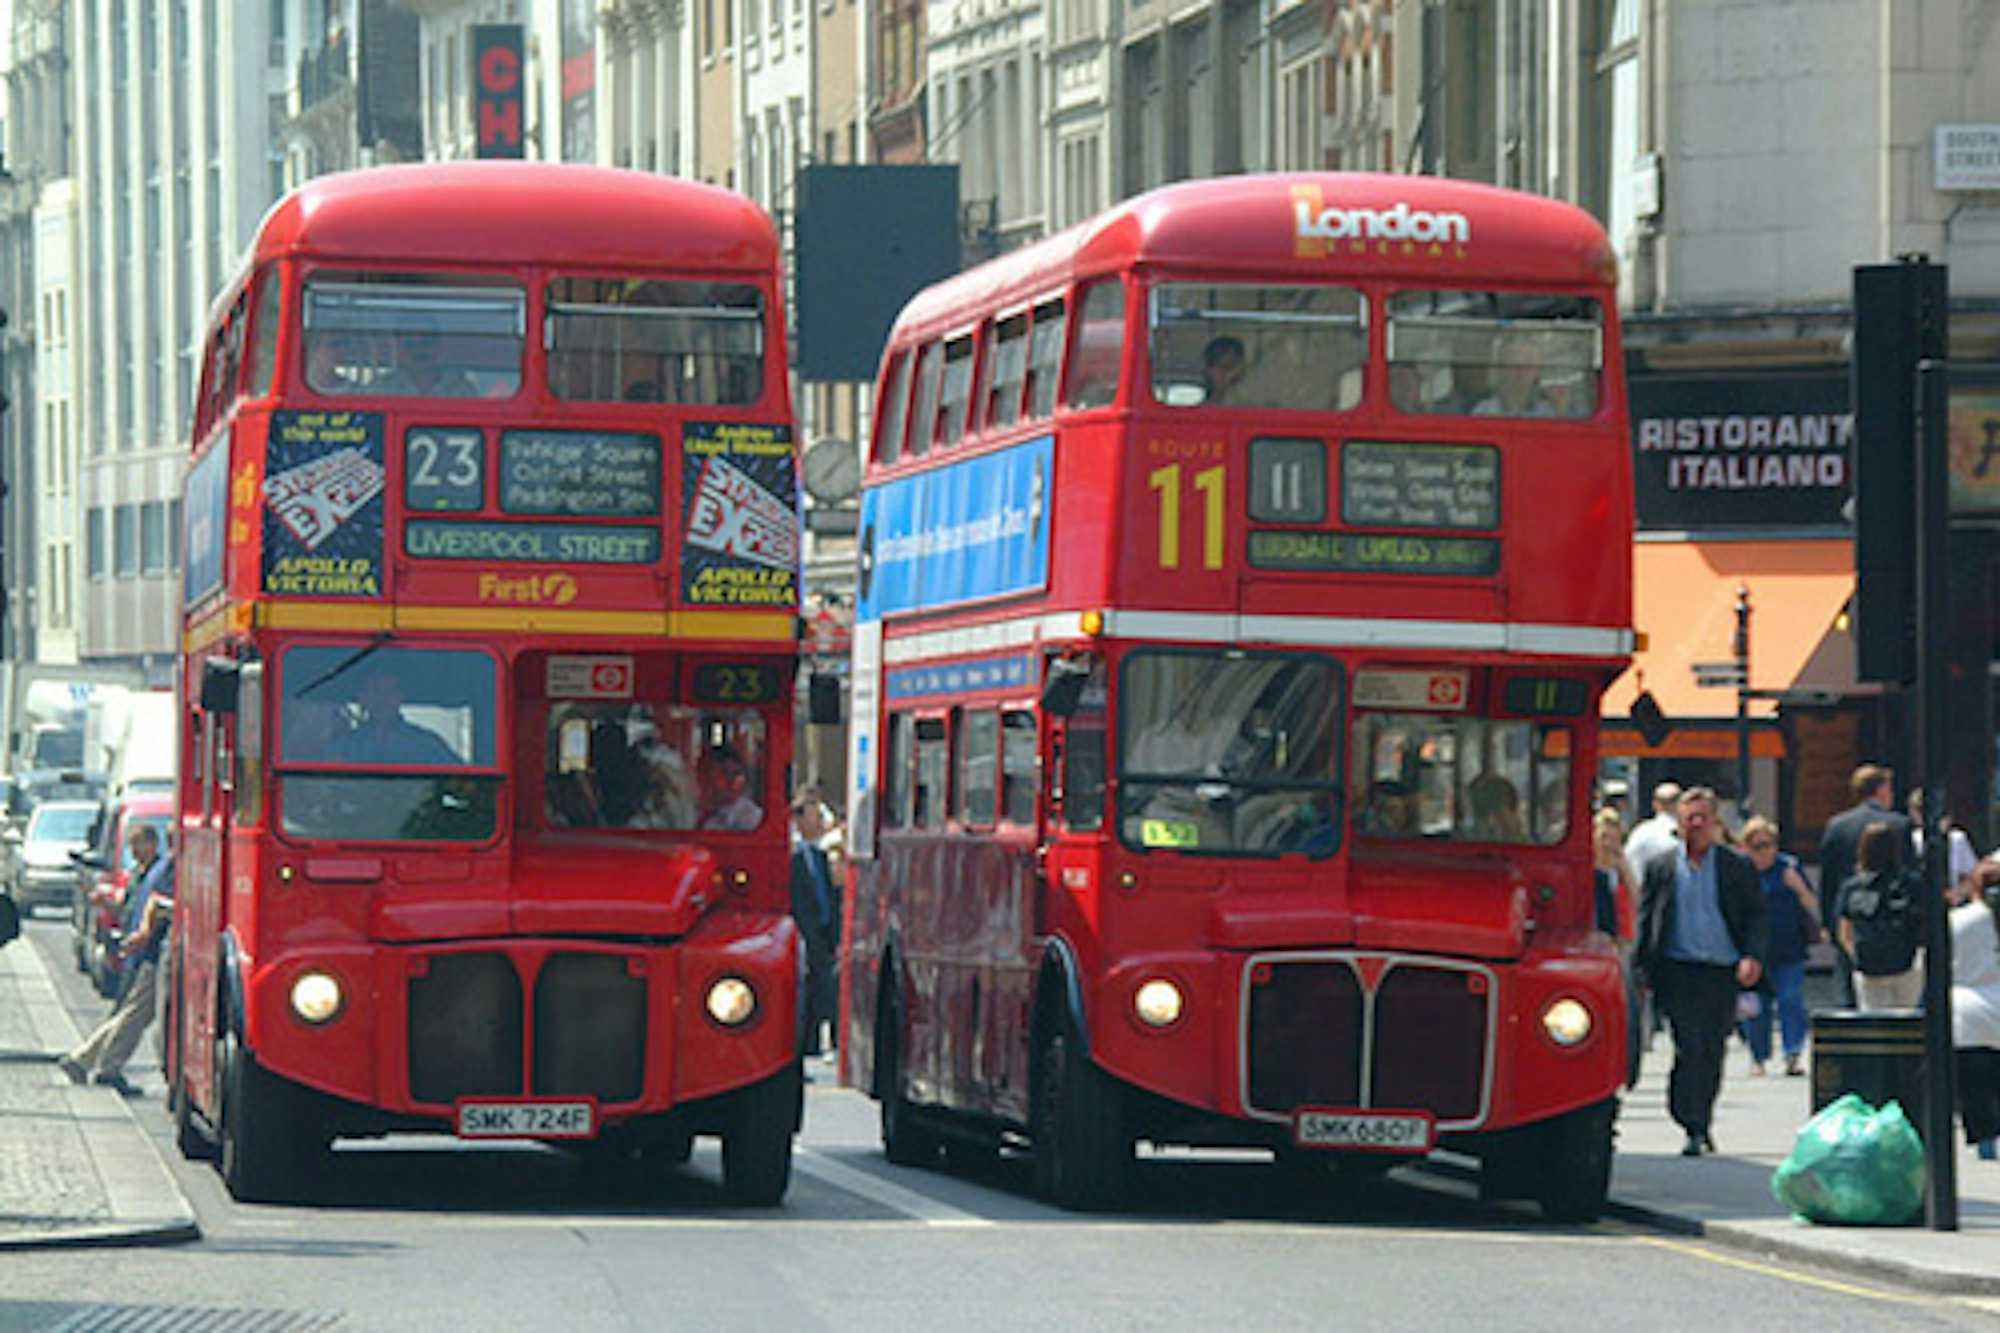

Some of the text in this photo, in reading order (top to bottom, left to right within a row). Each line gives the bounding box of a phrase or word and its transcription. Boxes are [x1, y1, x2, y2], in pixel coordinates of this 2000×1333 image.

[1295, 200, 1470, 242] London
[409, 436, 479, 486] 23
[1668, 455, 1844, 488] ITALIANO
[1271, 463, 1301, 511] 11
[1150, 462, 1224, 571] 11
[406, 528, 650, 562] LIVERPOOL STREET
[274, 559, 370, 575] APOLLO
[698, 568, 790, 585] APOLLO
[267, 575, 378, 593] VICTORIA
[479, 574, 542, 601] First
[690, 584, 797, 603] VICTORIA
[719, 668, 762, 698] 23
[464, 1108, 588, 1131] SMK 724F
